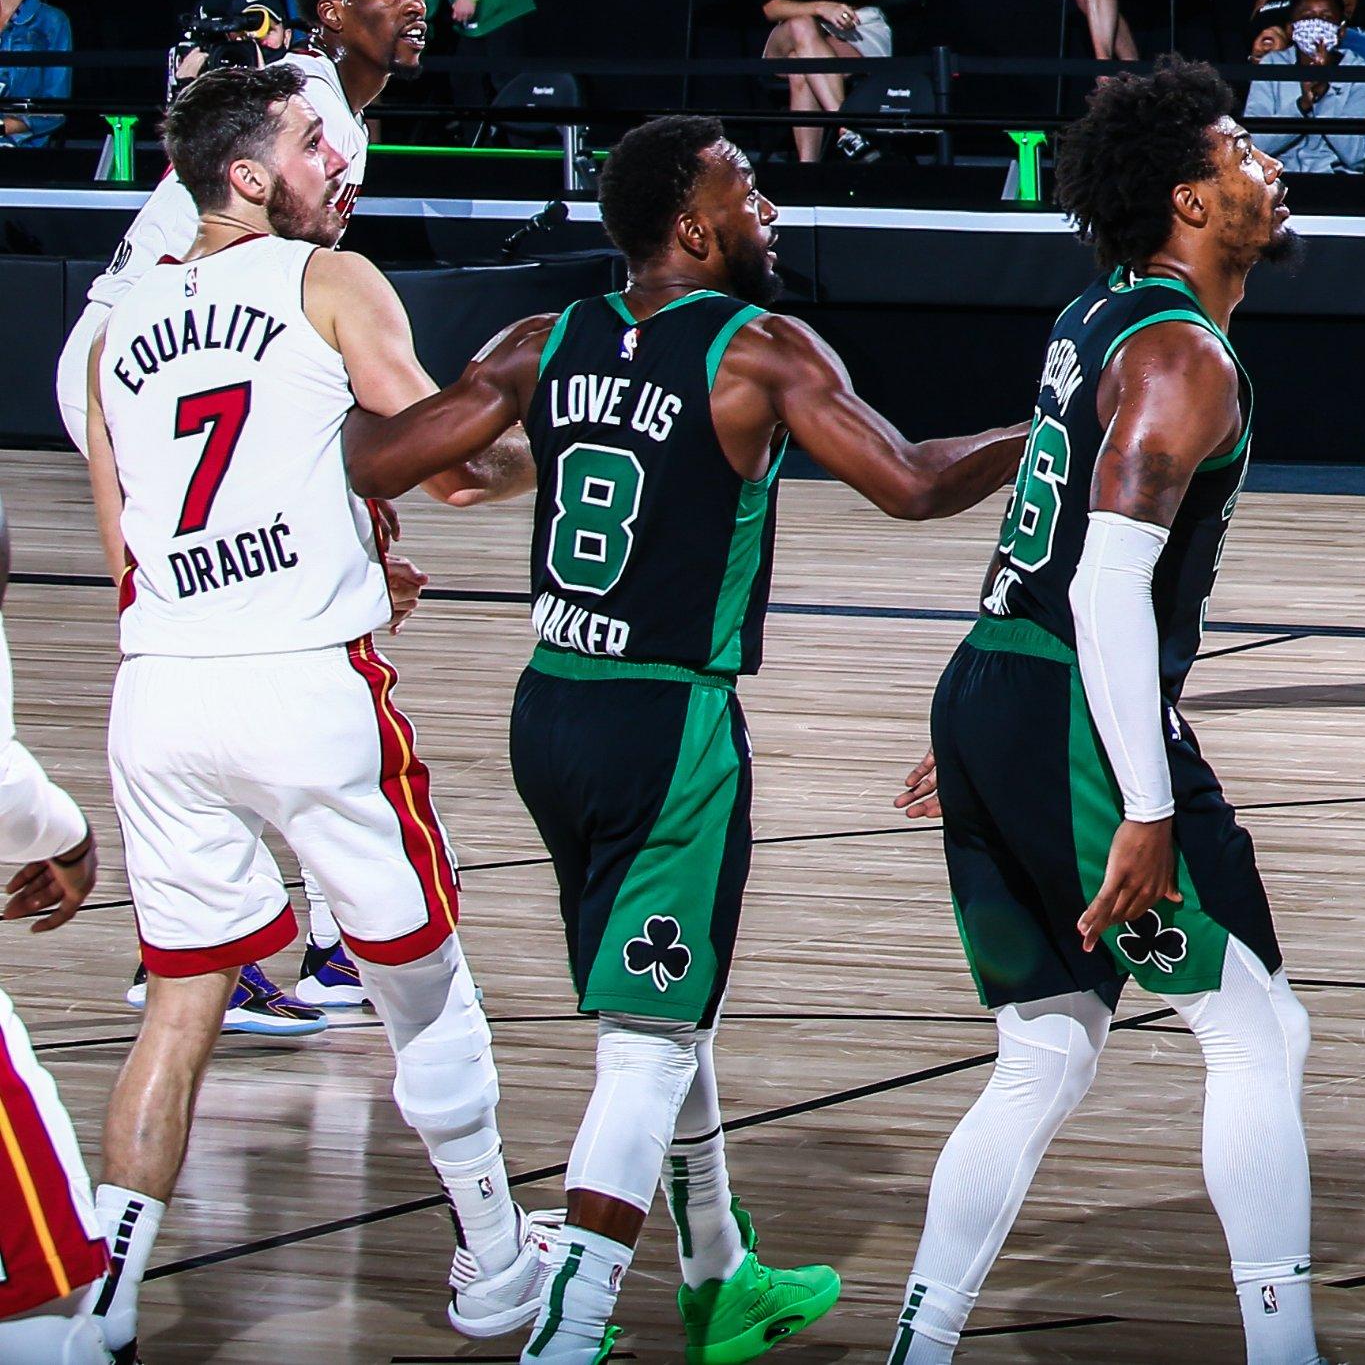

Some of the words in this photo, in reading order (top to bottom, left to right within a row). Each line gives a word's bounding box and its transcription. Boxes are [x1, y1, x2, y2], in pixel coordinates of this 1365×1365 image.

[114, 303, 287, 396] EQUALITY
[552, 374, 631, 428] LOVE
[631, 381, 682, 442] US
[172, 380, 252, 538] 7
[168, 513, 299, 599] DRAGIĆ
[547, 442, 644, 595] 8
[532, 591, 630, 658] WALKER
